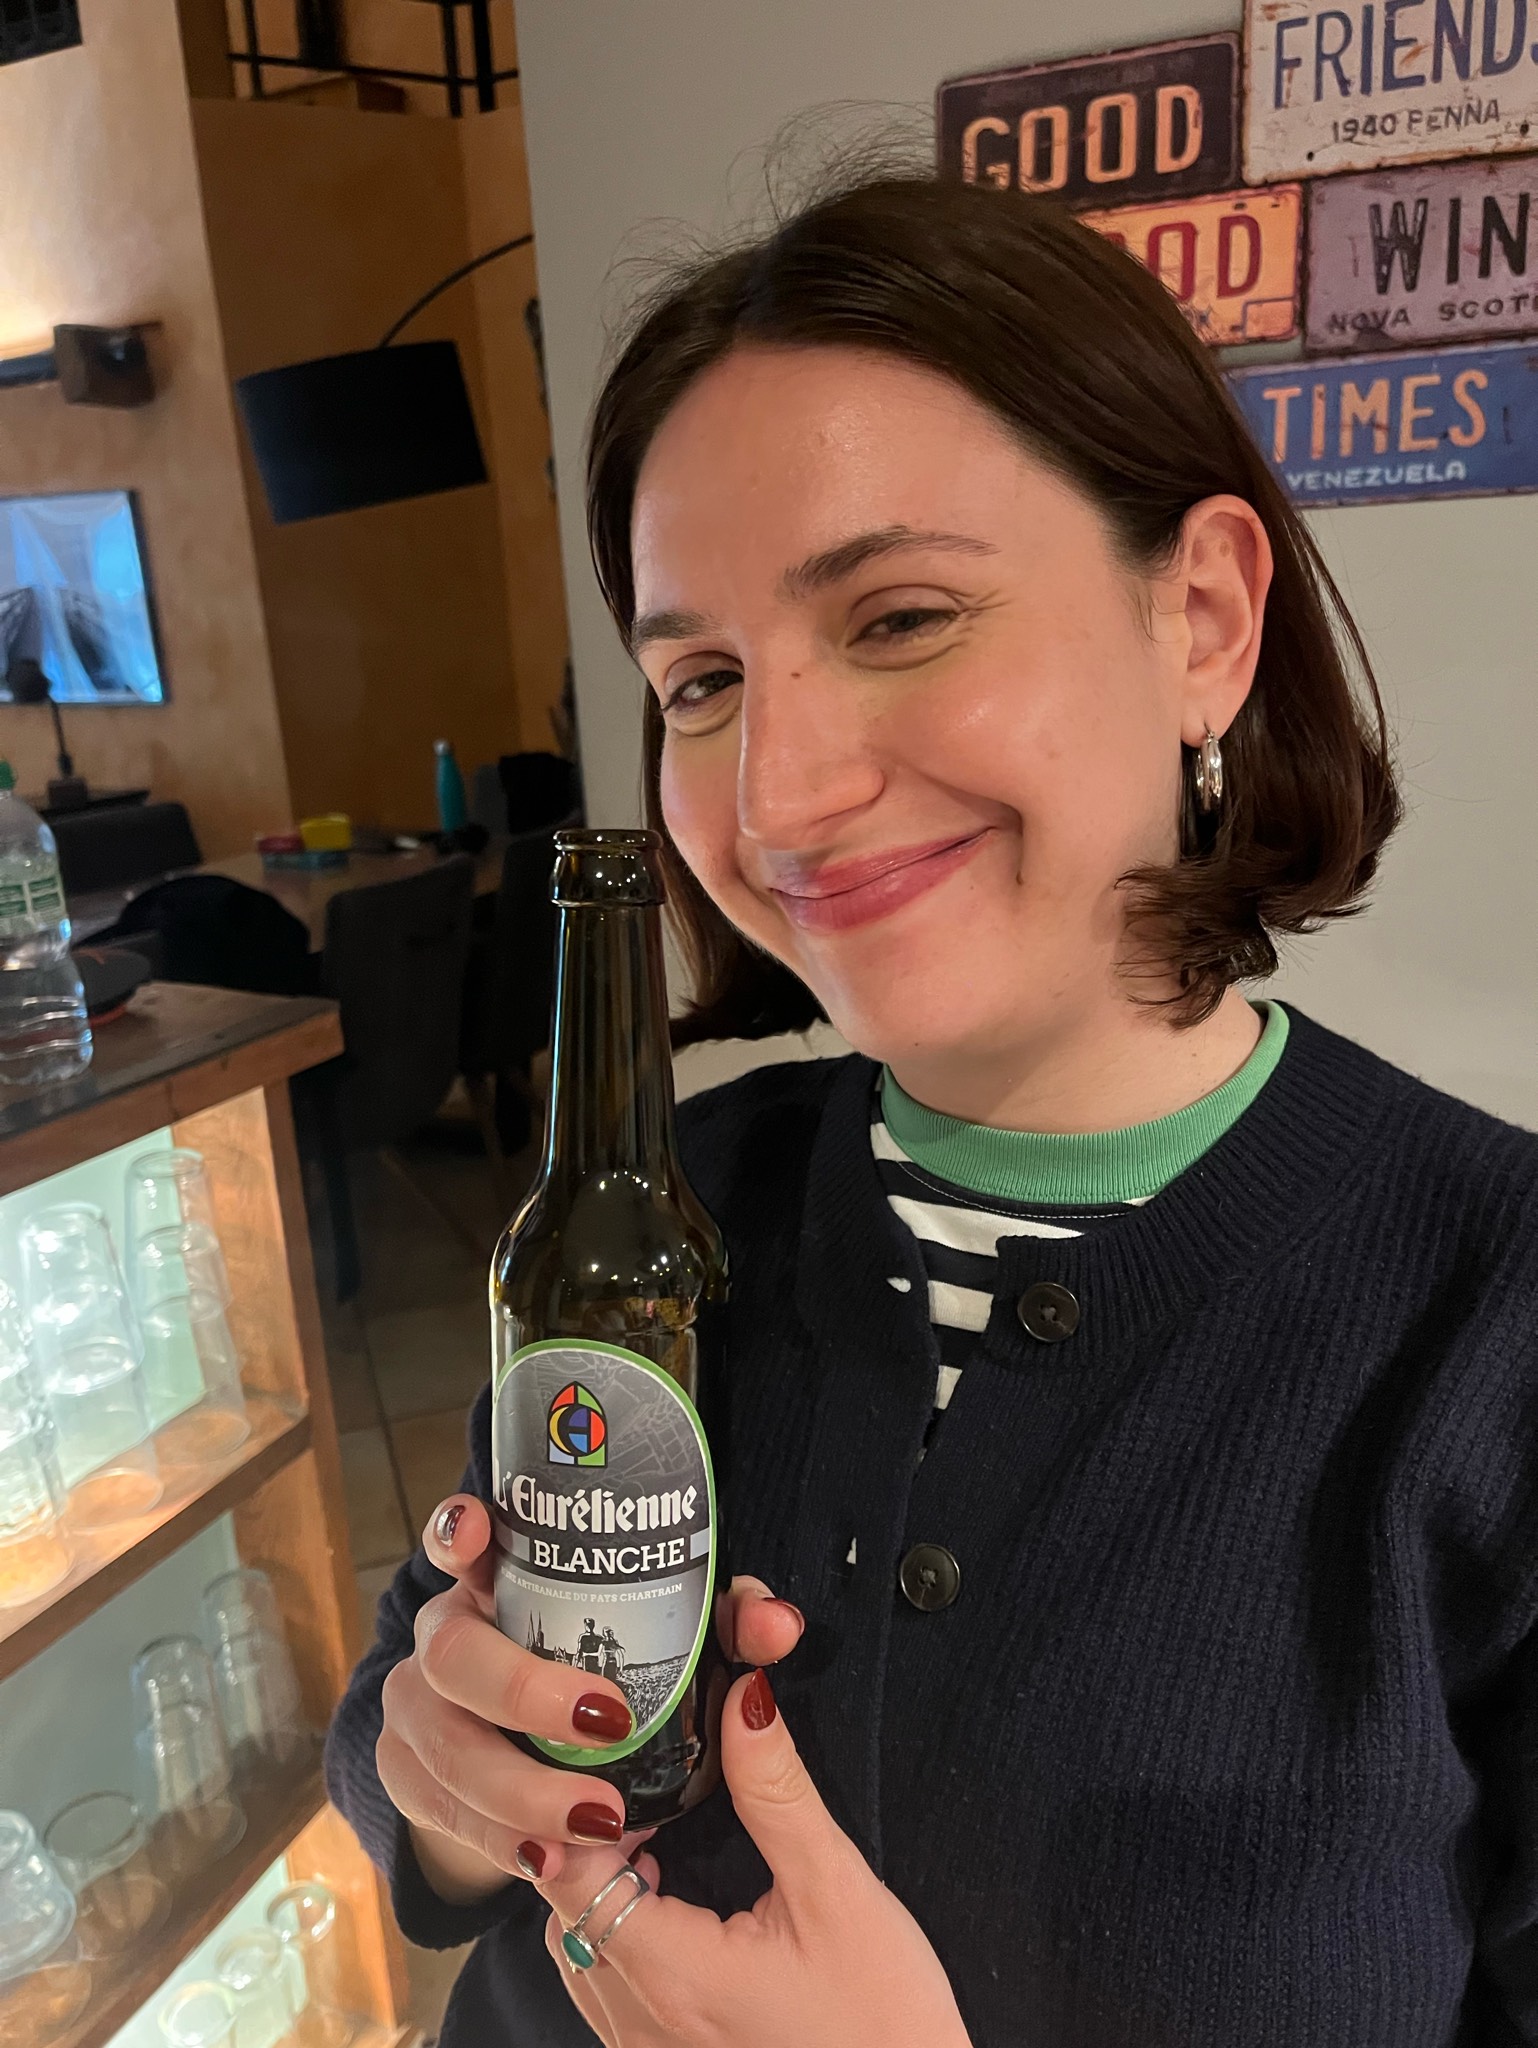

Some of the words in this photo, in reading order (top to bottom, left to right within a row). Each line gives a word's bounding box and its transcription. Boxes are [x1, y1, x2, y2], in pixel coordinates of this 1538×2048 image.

[1274, 0, 1538, 109] FRIEND
[962, 84, 1201, 194] GOOD
[1332, 113, 1397, 143] 1940
[1407, 98, 1501, 137] PENNA
[1103, 214, 1262, 302] OD
[1326, 308, 1412, 334] NOVA
[1263, 369, 1489, 463] TIMES
[1285, 460, 1468, 491] VENEZUELA
[533, 1538, 685, 1575] BLANCHE
[516, 1577, 572, 1601] ARTISANALE
[573, 1591, 588, 1603] DU
[590, 1593, 618, 1603] PAYS
[619, 1582, 683, 1602] CHARTRAIN
